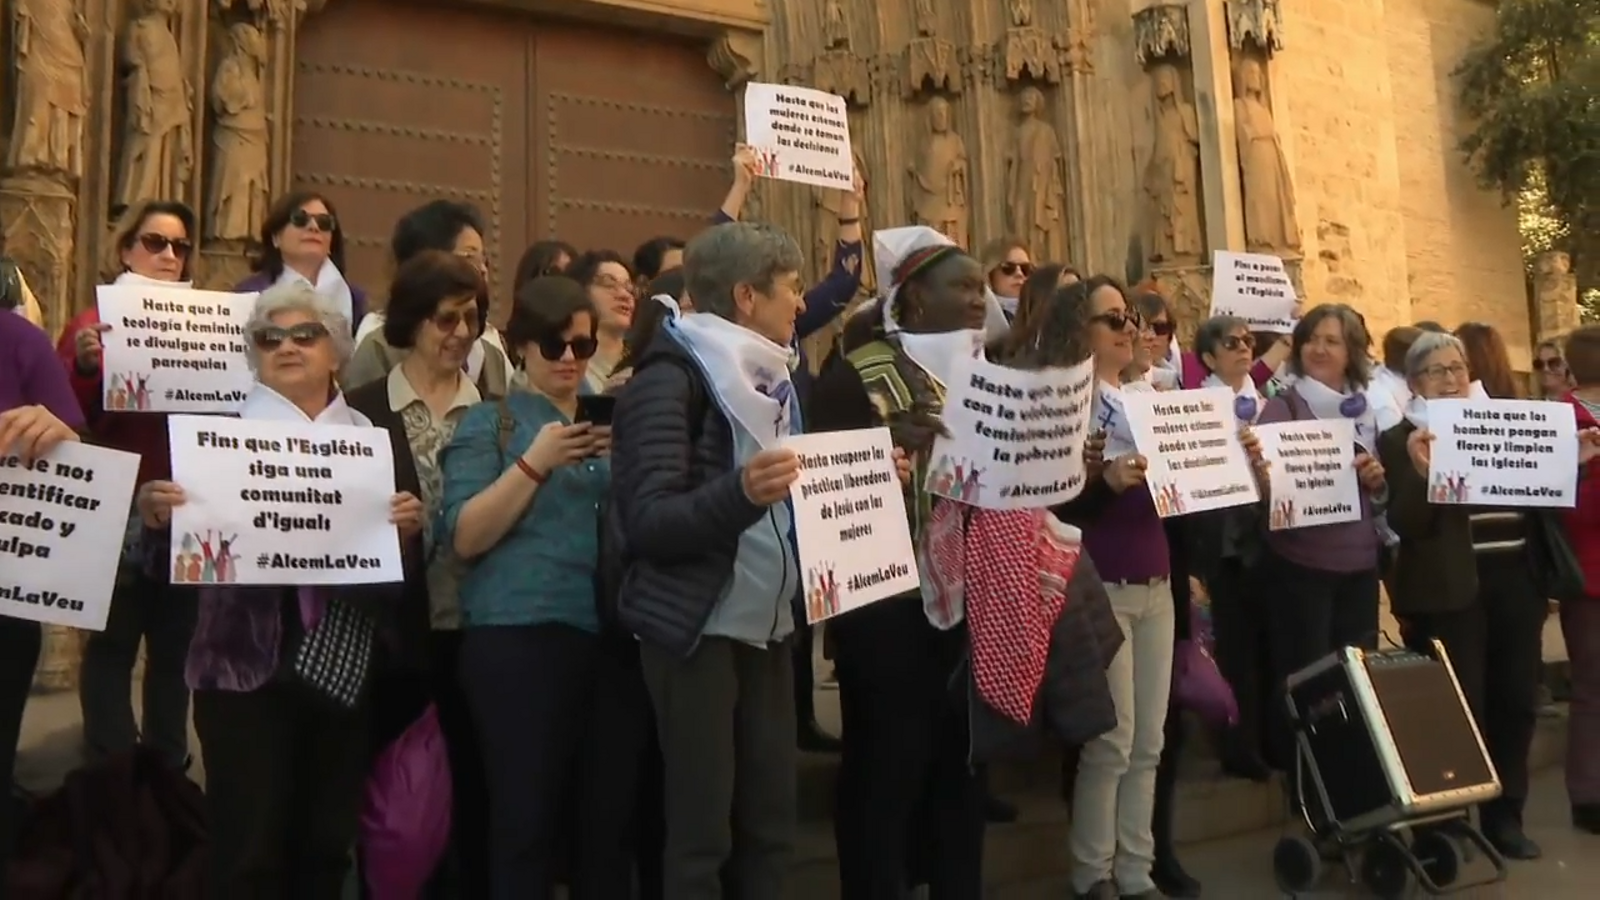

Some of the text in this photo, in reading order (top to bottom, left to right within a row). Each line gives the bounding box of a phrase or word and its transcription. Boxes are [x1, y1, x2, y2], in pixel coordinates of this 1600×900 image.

[776, 94, 806, 105] Hasta
[809, 100, 824, 110] que
[769, 108, 809, 121] mujeres
[816, 129, 844, 141] toman
[777, 135, 839, 155] las decisiones
[789, 165, 850, 181] #AlcemLaVeu
[1235, 260, 1250, 269] Fins
[142, 299, 230, 316] Hasta que la
[123, 317, 182, 332] teología
[127, 337, 140, 347] se
[144, 336, 206, 352] divulgue
[210, 341, 226, 352] en
[151, 357, 227, 371] parroquias
[970, 373, 1023, 400] Hasta
[165, 390, 247, 401] #AlcemLaVe
[963, 397, 993, 415] con
[997, 404, 1015, 421] la
[1153, 404, 1180, 416] Hasta
[1183, 404, 1199, 414] que
[1463, 409, 1546, 421] Hasta que los
[1153, 422, 1188, 434] mujeres
[1453, 424, 1557, 438] hombres pongan
[1280, 432, 1305, 441] Hasta
[1305, 433, 1321, 441] que
[197, 431, 374, 458] Fins que l'Església
[1158, 440, 1185, 453] donde
[1189, 441, 1197, 450] se
[1278, 447, 1341, 457] hombres pongan
[1457, 440, 1553, 453] flores y limpien
[798, 445, 885, 470] Hasta recuperar las
[993, 446, 1072, 465] la pobreza
[1472, 456, 1538, 469] las iglesias
[55, 463, 94, 482] nos
[249, 460, 332, 479] siga una
[1167, 459, 1181, 471] las
[1285, 462, 1342, 474] flores y limpien
[801, 471, 890, 500] prácticas liberadoras
[1295, 479, 1334, 489] las iglesias
[1481, 485, 1562, 497] #AlcemLaVeu
[240, 488, 342, 504] comunitat
[820, 495, 883, 519] de Jesús con las
[1303, 503, 1352, 516] #AlcemLaVeu
[59, 521, 76, 537] y
[253, 512, 331, 532] d'iguals
[839, 523, 872, 542] mujeres
[256, 553, 381, 569] #AlcemLaVeu
[847, 563, 908, 592] #AlcemLaVeu
